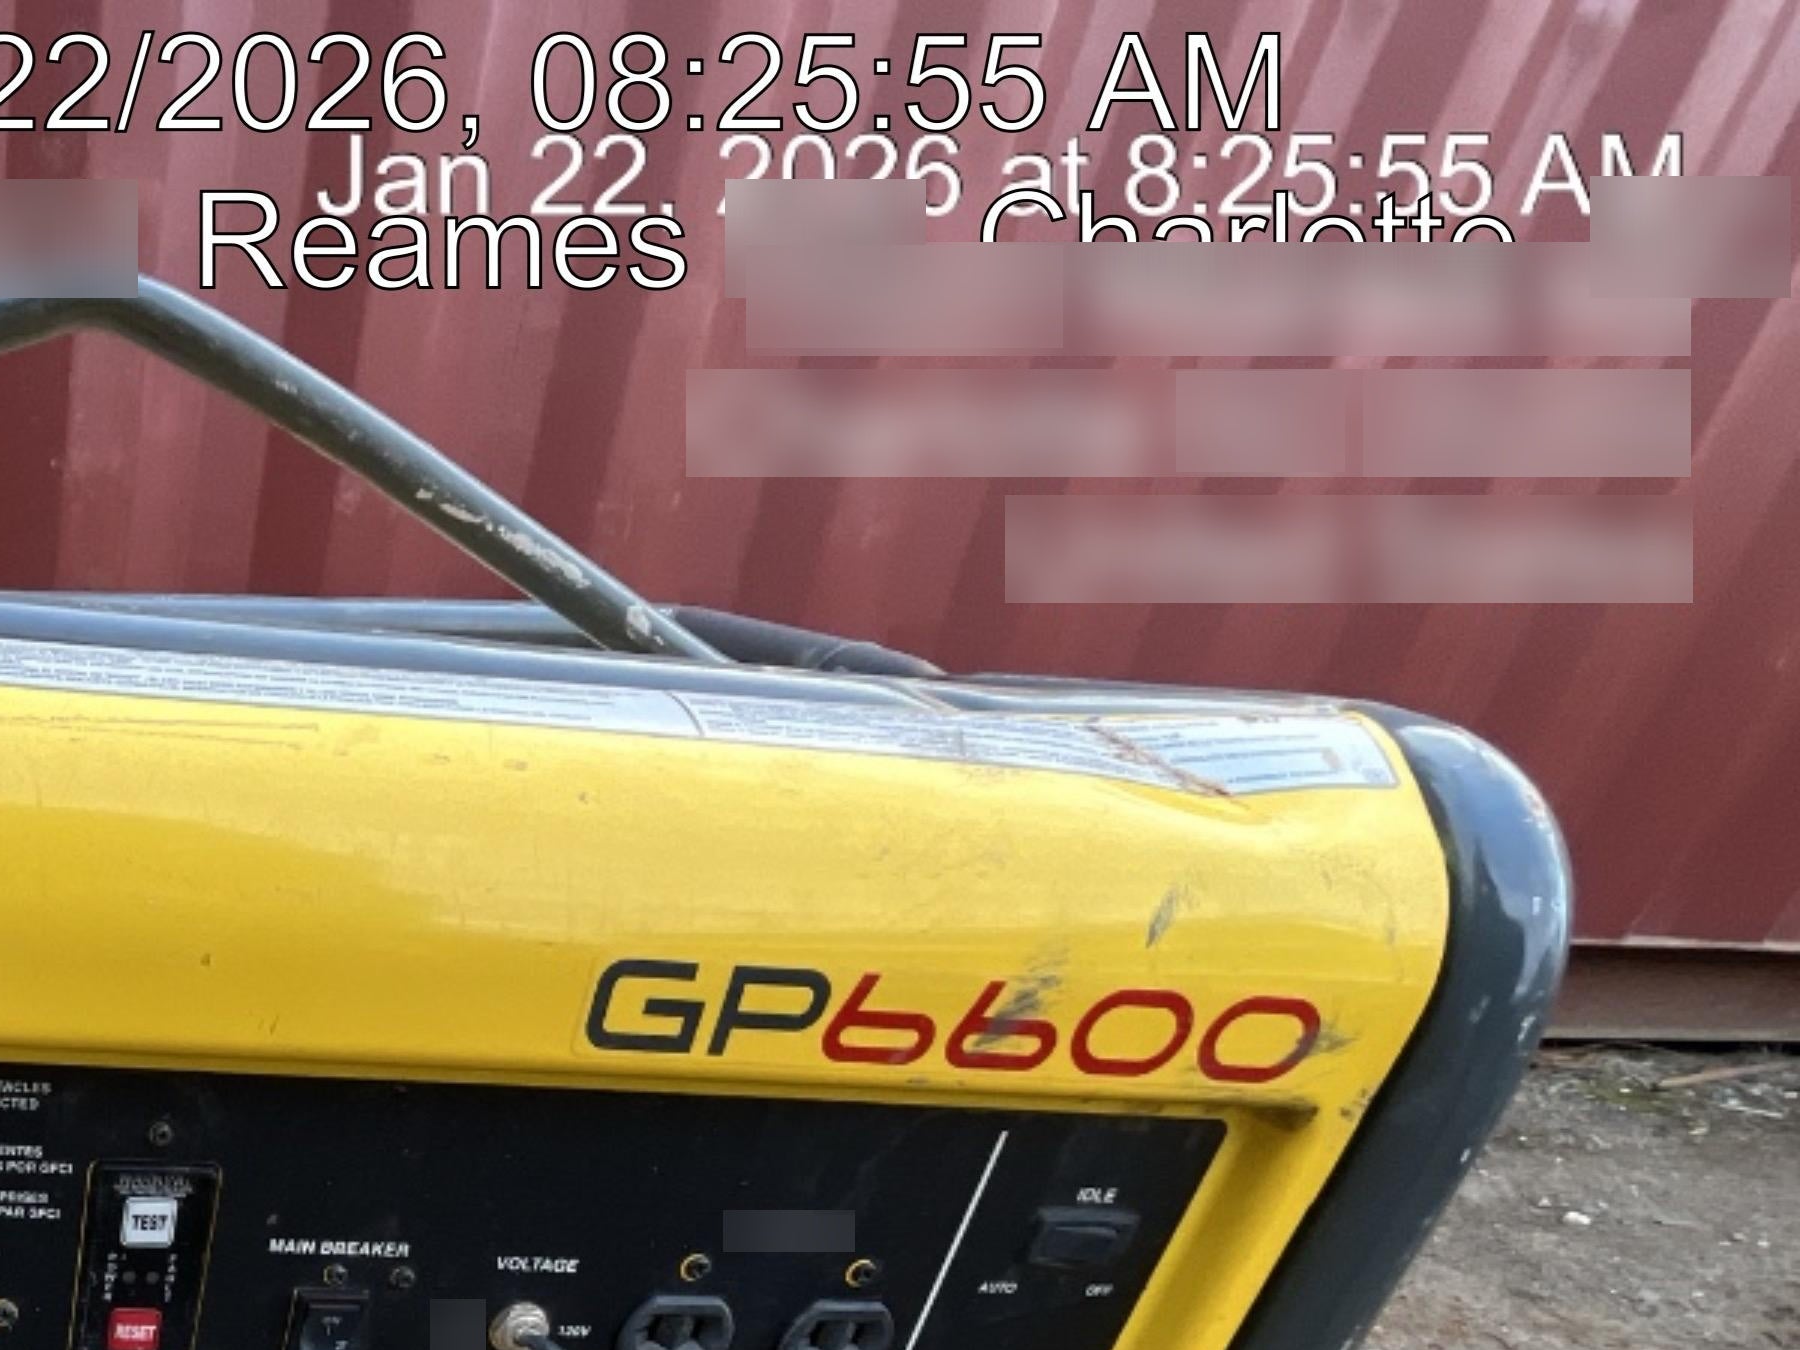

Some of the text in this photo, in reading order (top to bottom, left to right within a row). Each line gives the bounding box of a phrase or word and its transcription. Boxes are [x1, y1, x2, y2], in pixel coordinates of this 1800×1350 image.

[585, 959, 1321, 1083] GP6600
[1076, 1187, 1118, 1203] IDLE
[131, 1214, 169, 1231] TEST
[269, 1238, 410, 1258] MAIN BREAKER
[496, 1256, 580, 1274] VOLTAGE
[978, 1281, 1018, 1294] AUTO
[1085, 1283, 1114, 1297] OFF
[114, 1323, 157, 1342] RESET
[558, 1325, 592, 1337] 120V
